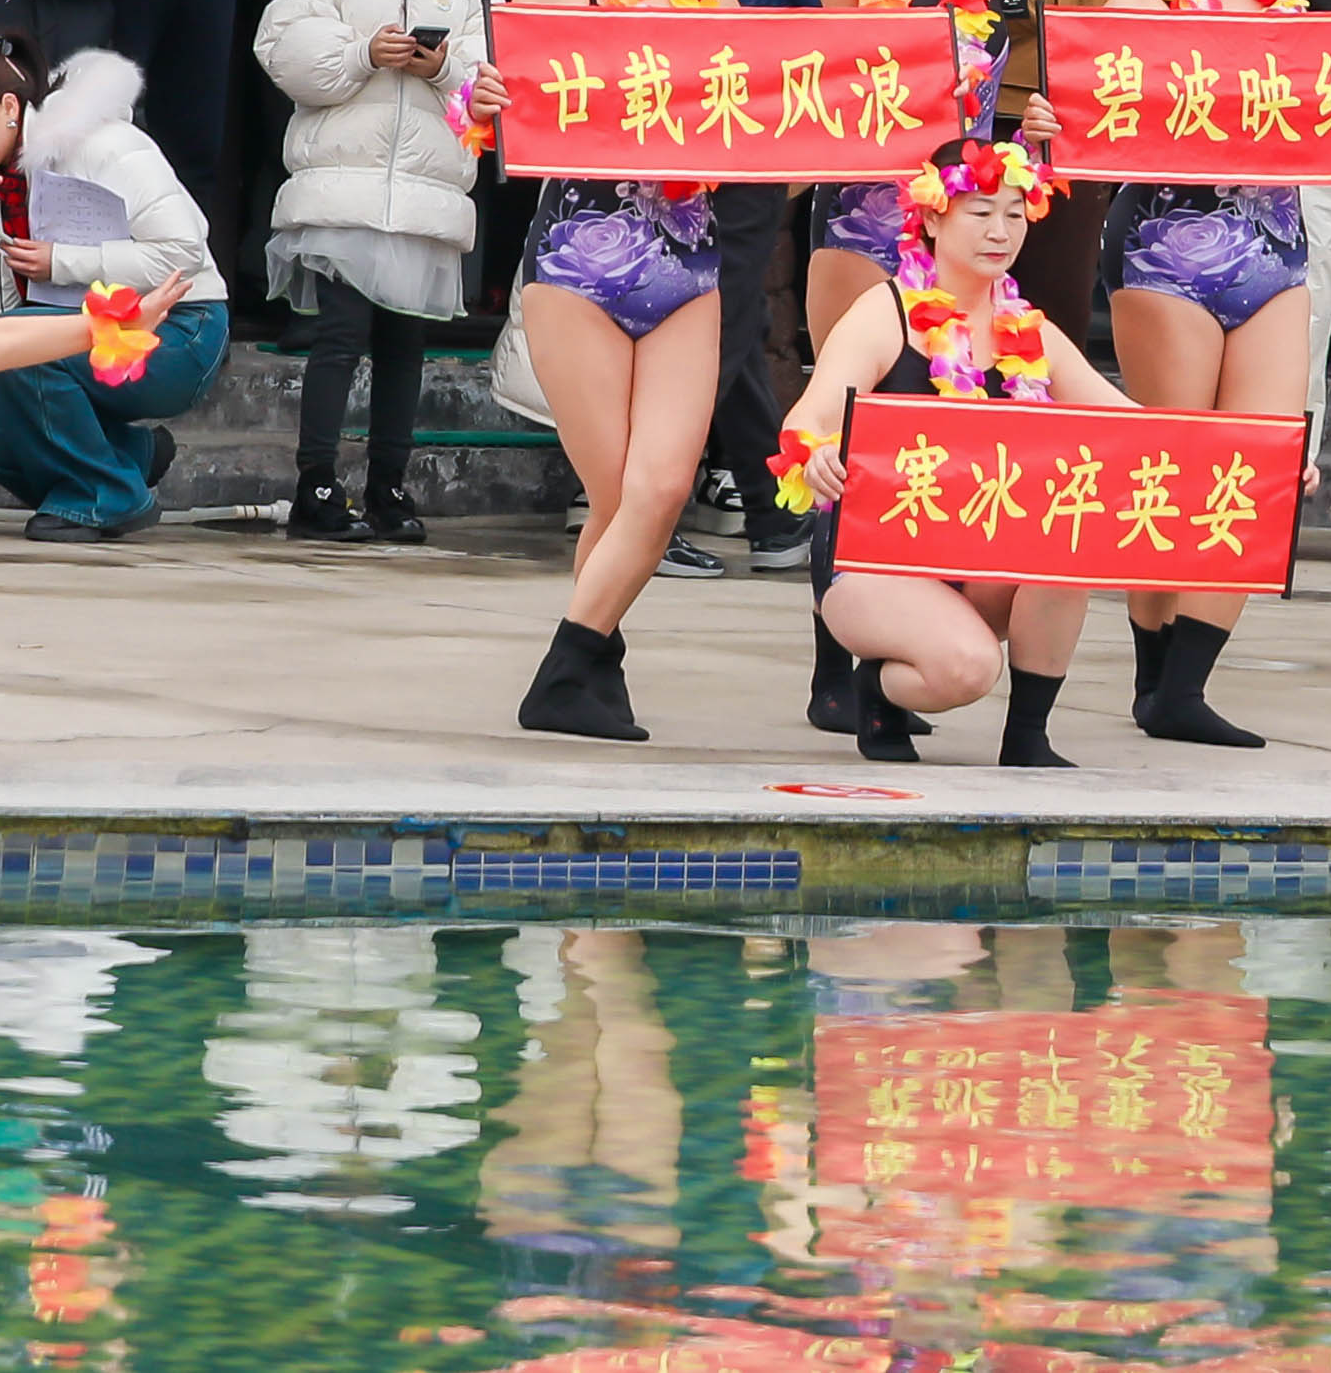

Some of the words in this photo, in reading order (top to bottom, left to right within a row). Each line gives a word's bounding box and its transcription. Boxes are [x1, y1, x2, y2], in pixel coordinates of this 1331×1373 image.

[540, 44, 924, 149] 廿载乘风浪
[879, 433, 1258, 556] 寒冰淬英姿
